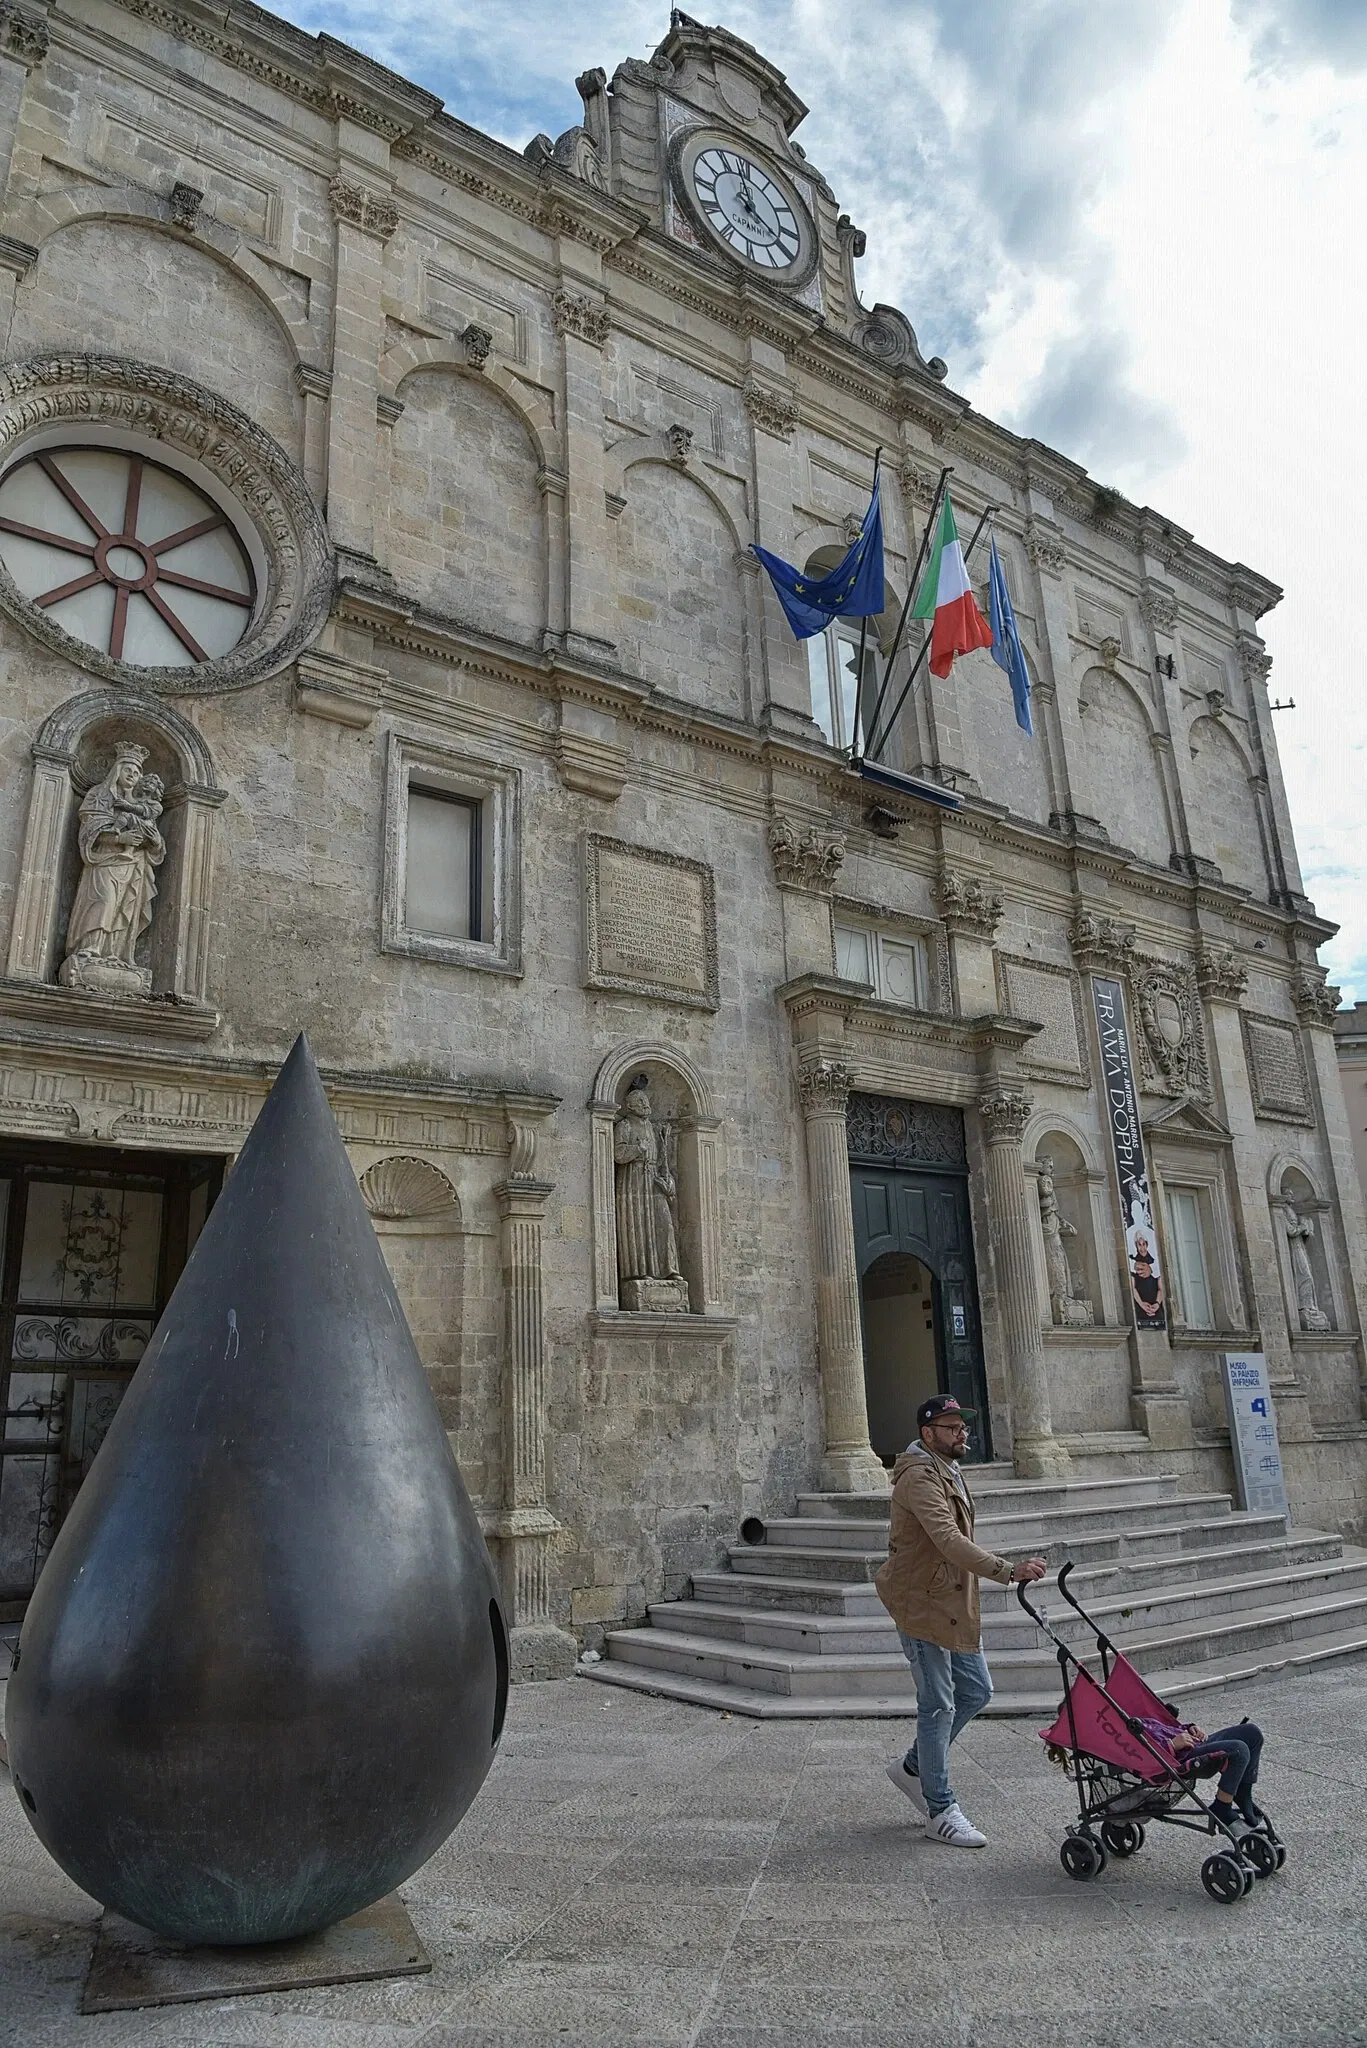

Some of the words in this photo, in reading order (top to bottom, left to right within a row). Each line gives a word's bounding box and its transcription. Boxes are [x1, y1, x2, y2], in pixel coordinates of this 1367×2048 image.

[732, 213, 766, 238] CAPANNI
[1117, 1028, 1126, 1053] MARIA
[1097, 990, 1121, 1077] TRAMA
[1110, 1089, 1137, 1185] DOPPIA
[1123, 1078, 1135, 1112] ANTONIO
[1128, 1114, 1139, 1149] MARRAS
[1229, 1362, 1247, 1370] MUSEO
[1096, 1707, 1144, 1762] tour
